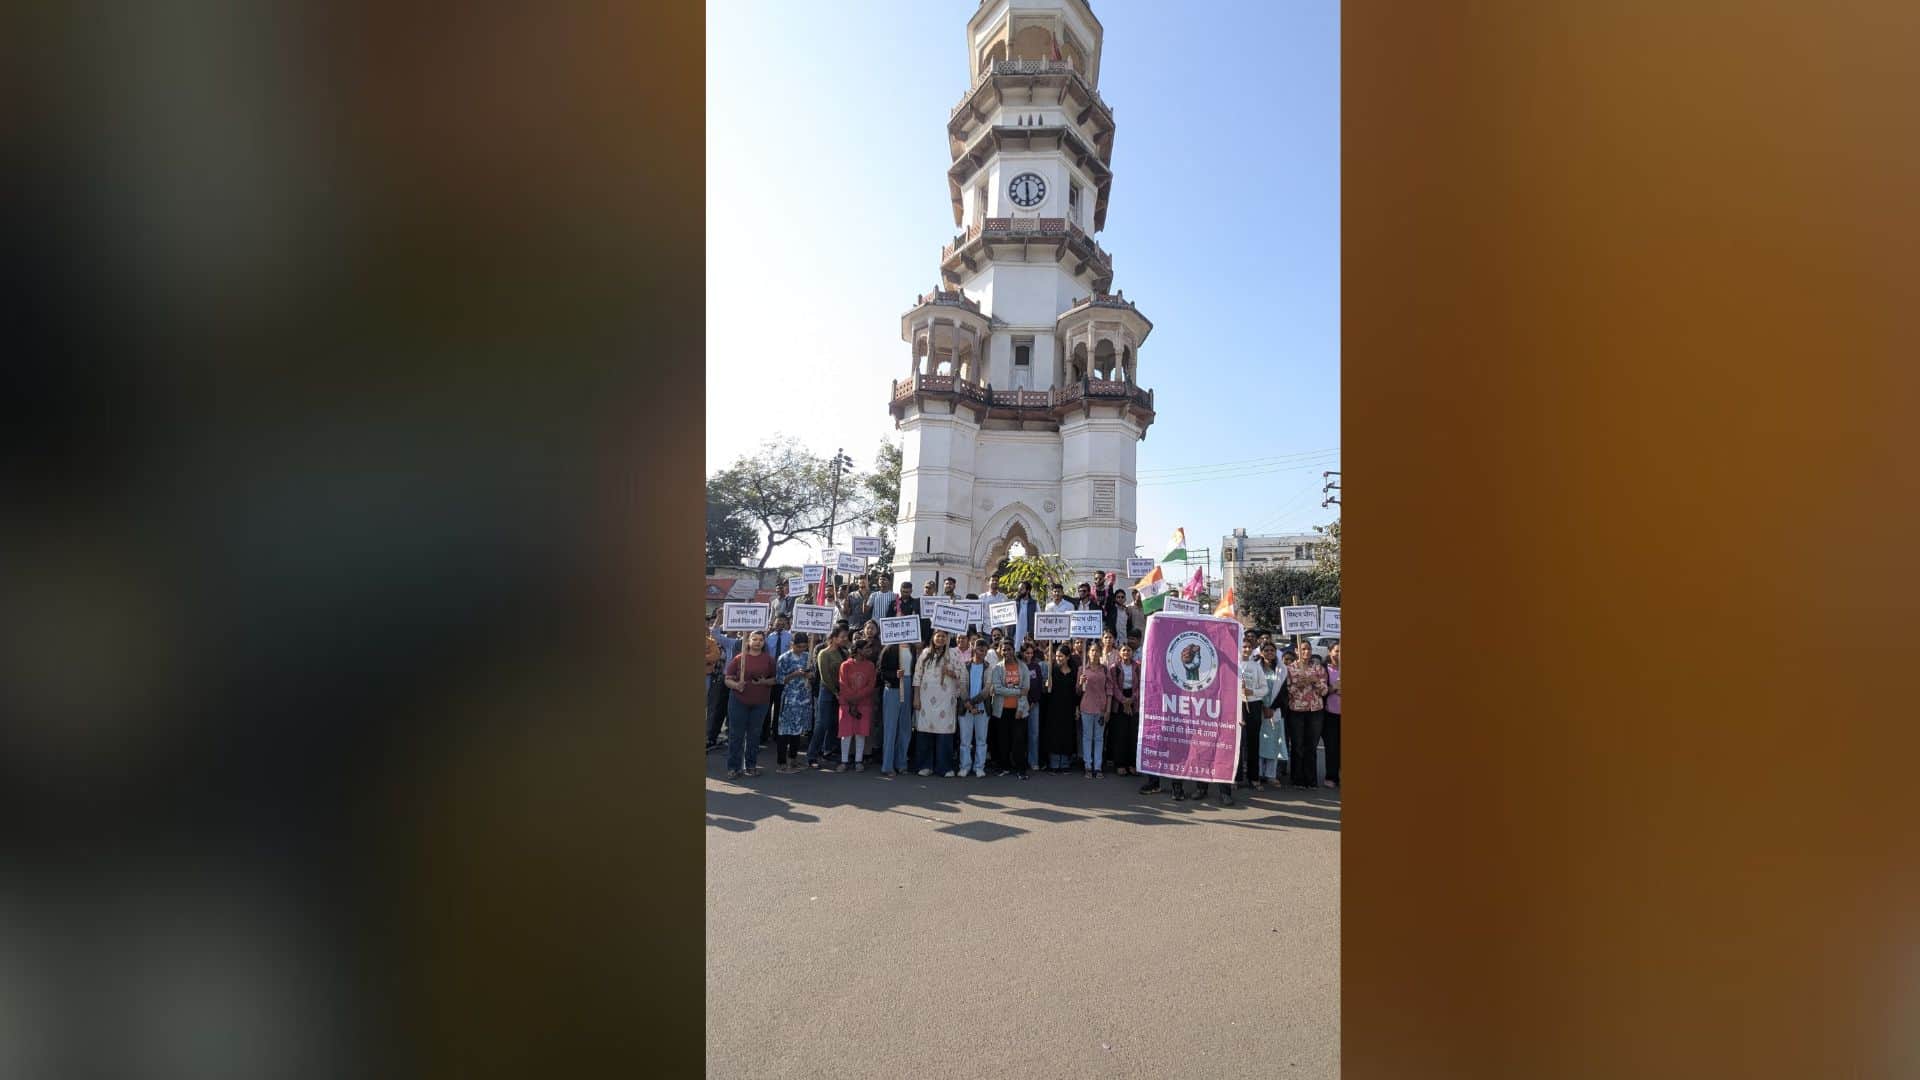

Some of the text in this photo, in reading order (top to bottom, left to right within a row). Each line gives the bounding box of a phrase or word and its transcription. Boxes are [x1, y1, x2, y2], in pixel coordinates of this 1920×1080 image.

[1162, 694, 1220, 719] NEYU
[1145, 713, 1170, 721] National
[1201, 720, 1217, 728] Youth
